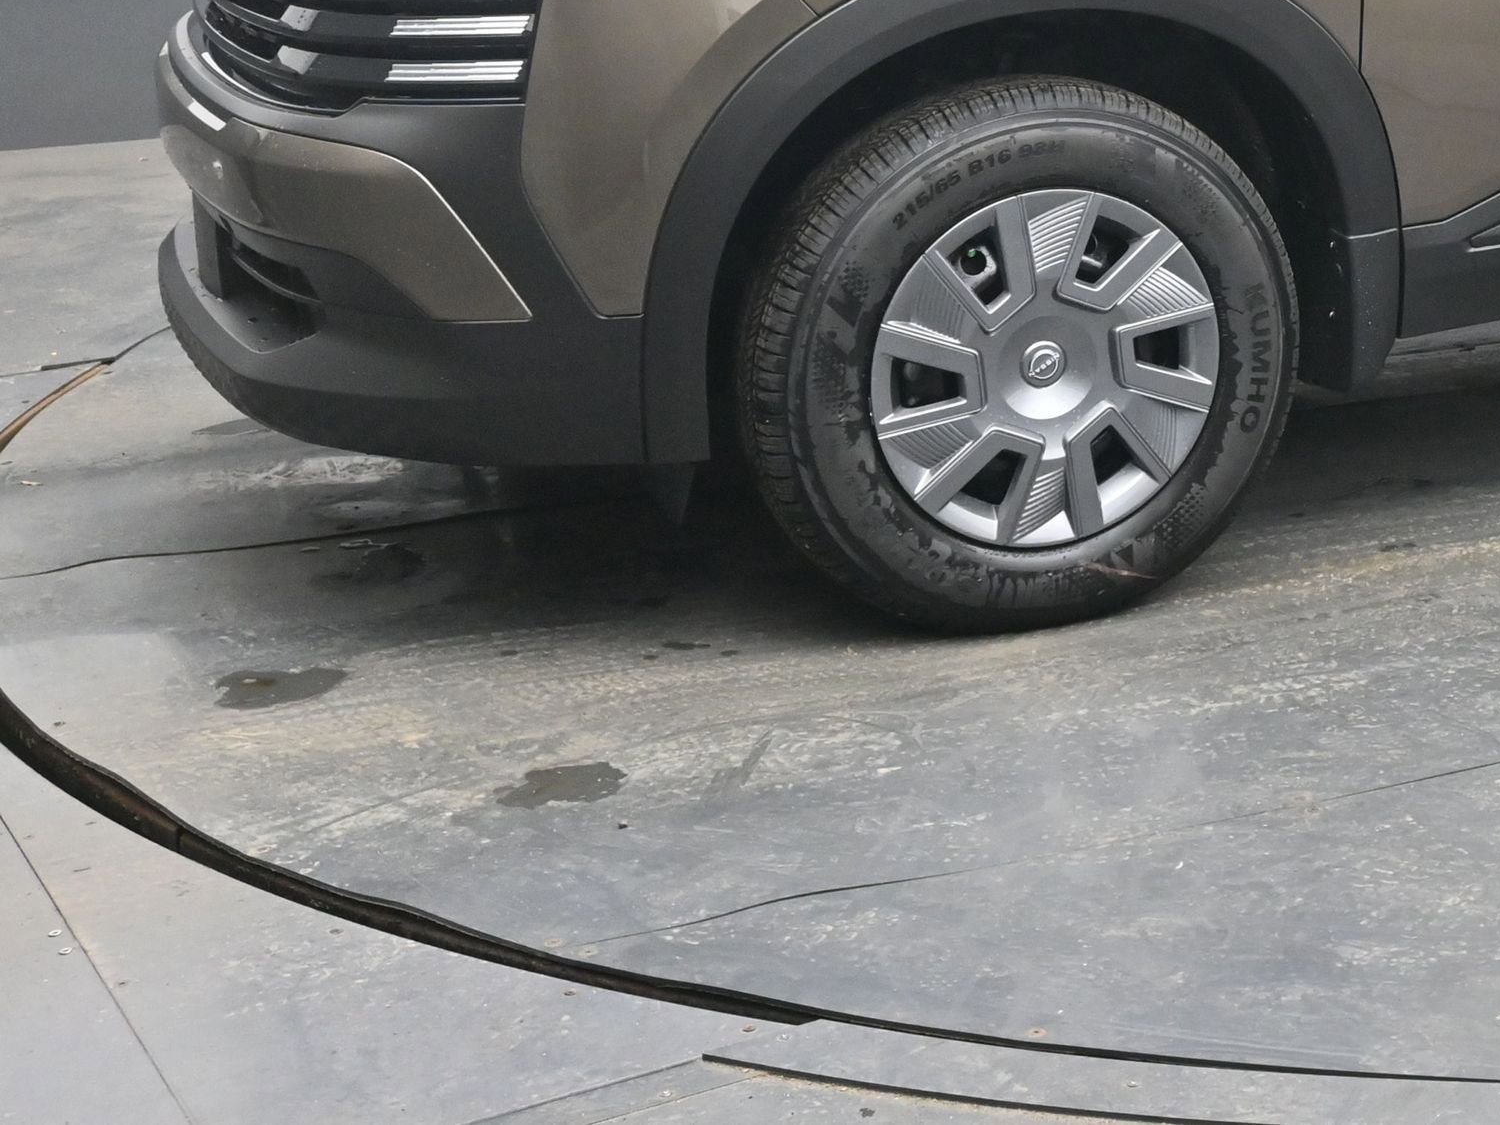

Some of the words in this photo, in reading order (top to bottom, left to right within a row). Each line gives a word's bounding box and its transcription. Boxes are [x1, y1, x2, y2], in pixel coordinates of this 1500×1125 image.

[893, 170, 961, 231] 215/65
[967, 149, 1012, 176] R16
[1239, 282, 1272, 434] KUMHO
